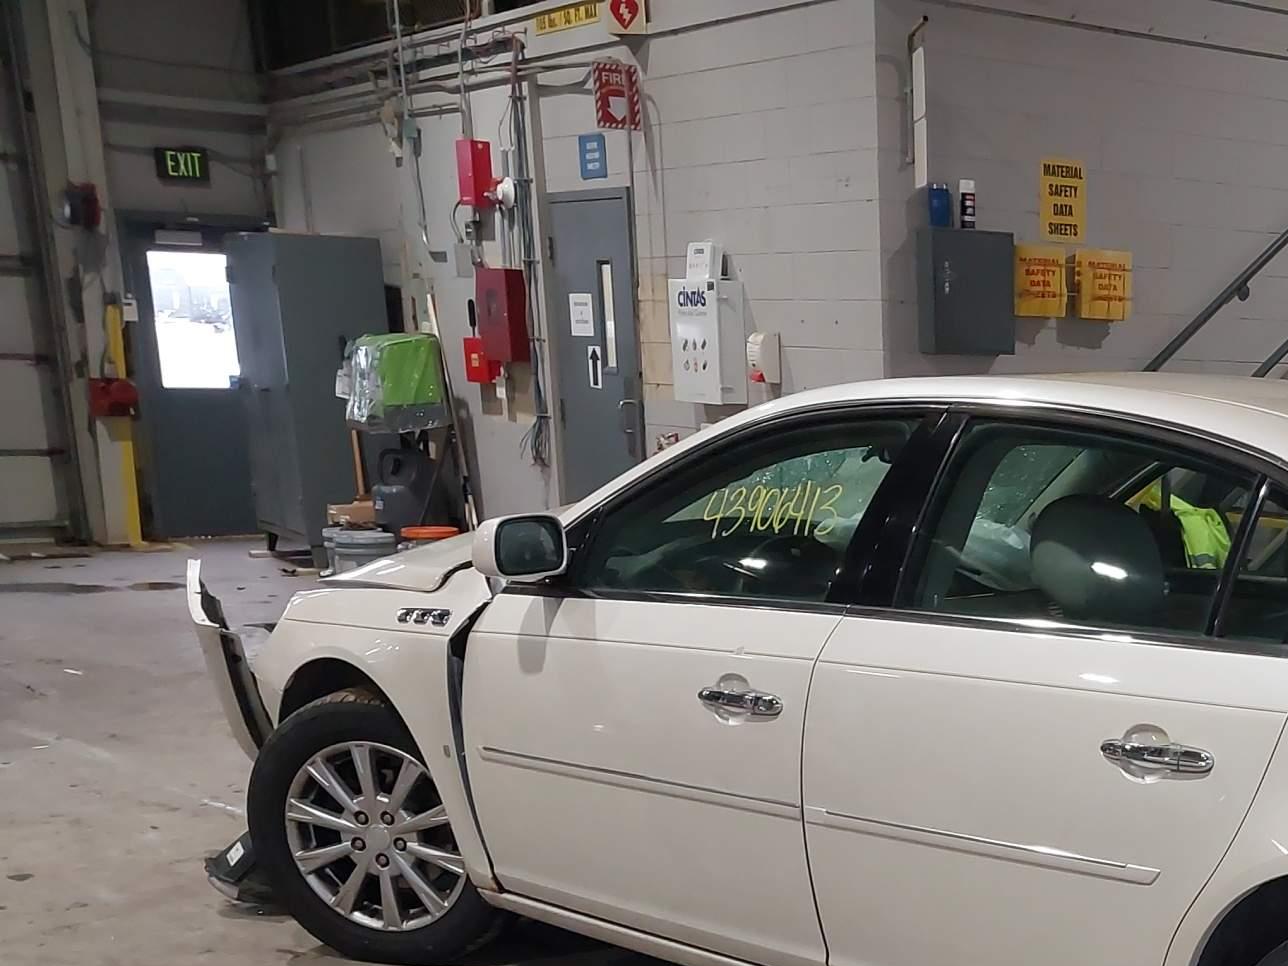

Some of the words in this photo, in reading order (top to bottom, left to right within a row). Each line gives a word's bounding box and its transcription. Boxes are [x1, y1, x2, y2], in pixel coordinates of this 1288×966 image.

[601, 71, 625, 86] FIR
[165, 150, 202, 178] EXIT
[1043, 163, 1083, 180] MATERIAL
[1048, 183, 1078, 198] SAFETY
[1052, 203, 1074, 217] DATA
[1048, 222, 1078, 237] SHEETS
[703, 480, 843, 539] 43906413
